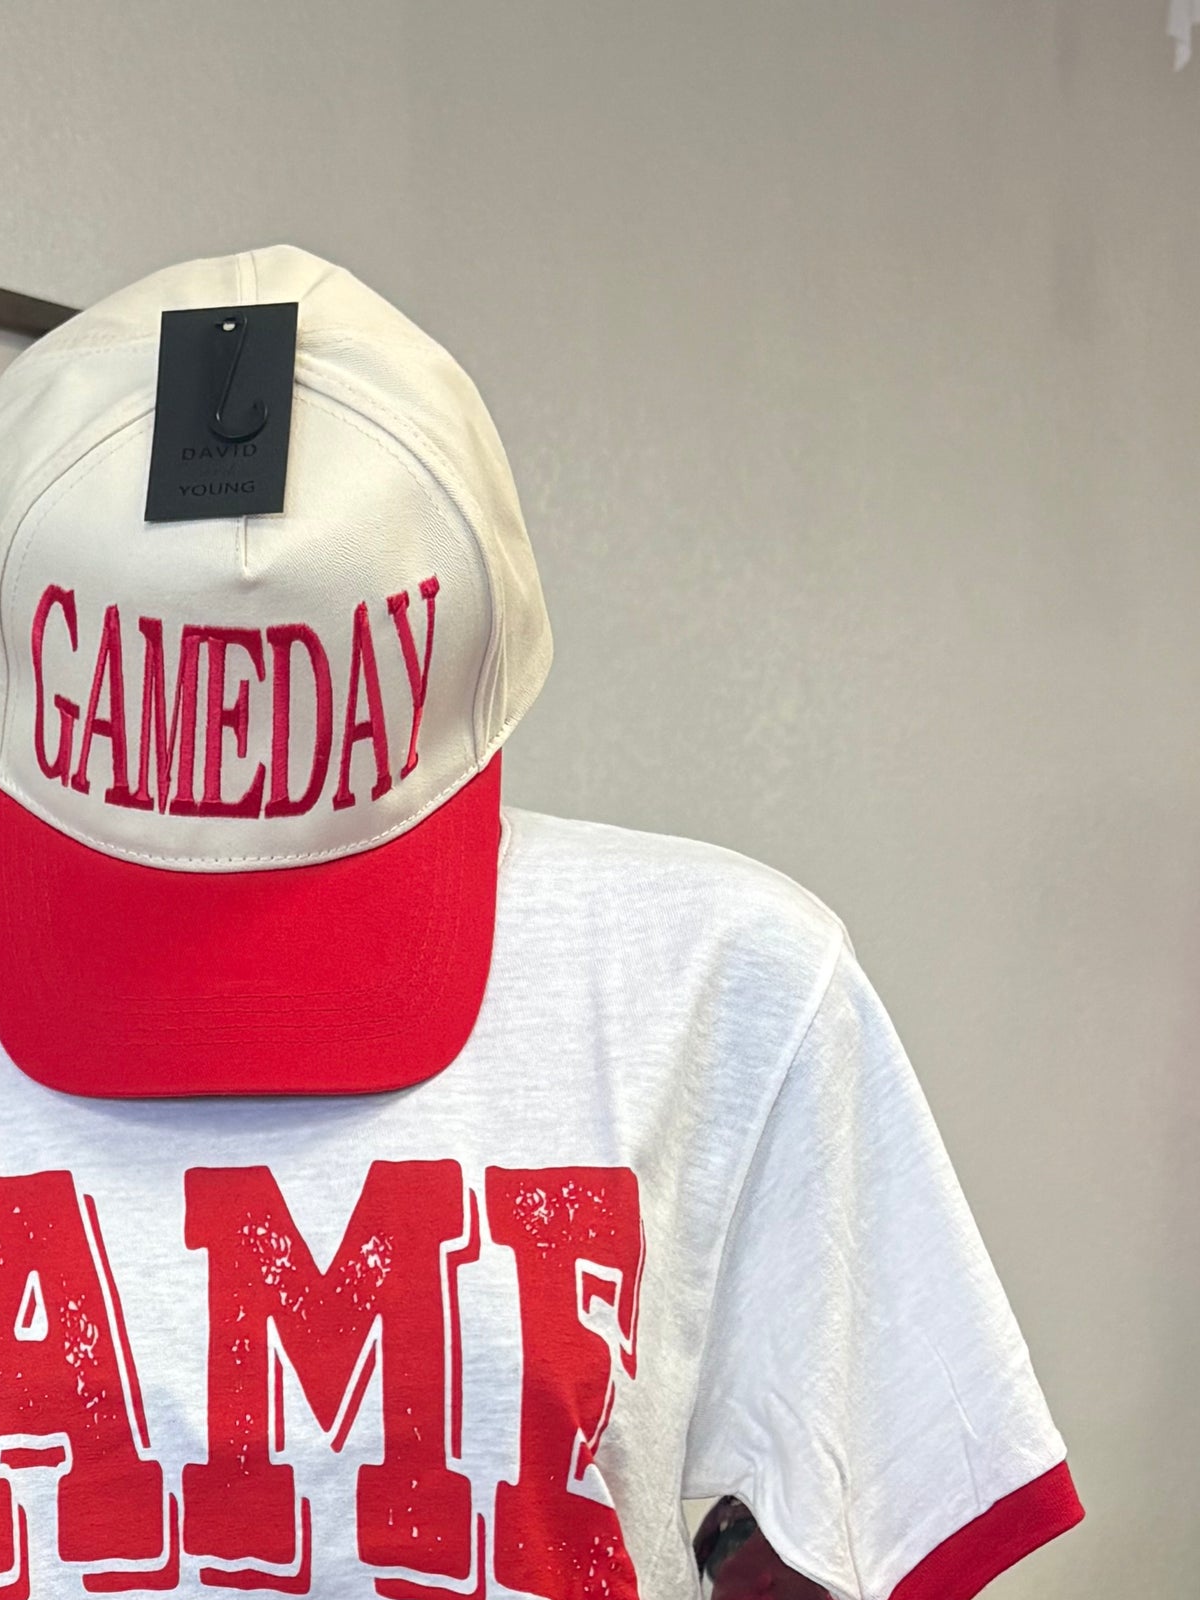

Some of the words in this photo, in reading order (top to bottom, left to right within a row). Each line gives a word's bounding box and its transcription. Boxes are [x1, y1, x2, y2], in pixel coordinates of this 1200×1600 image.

[181, 444, 258, 461] DAVID
[178, 480, 256, 497] YOUNG
[31, 574, 440, 819] GAMEDAY
